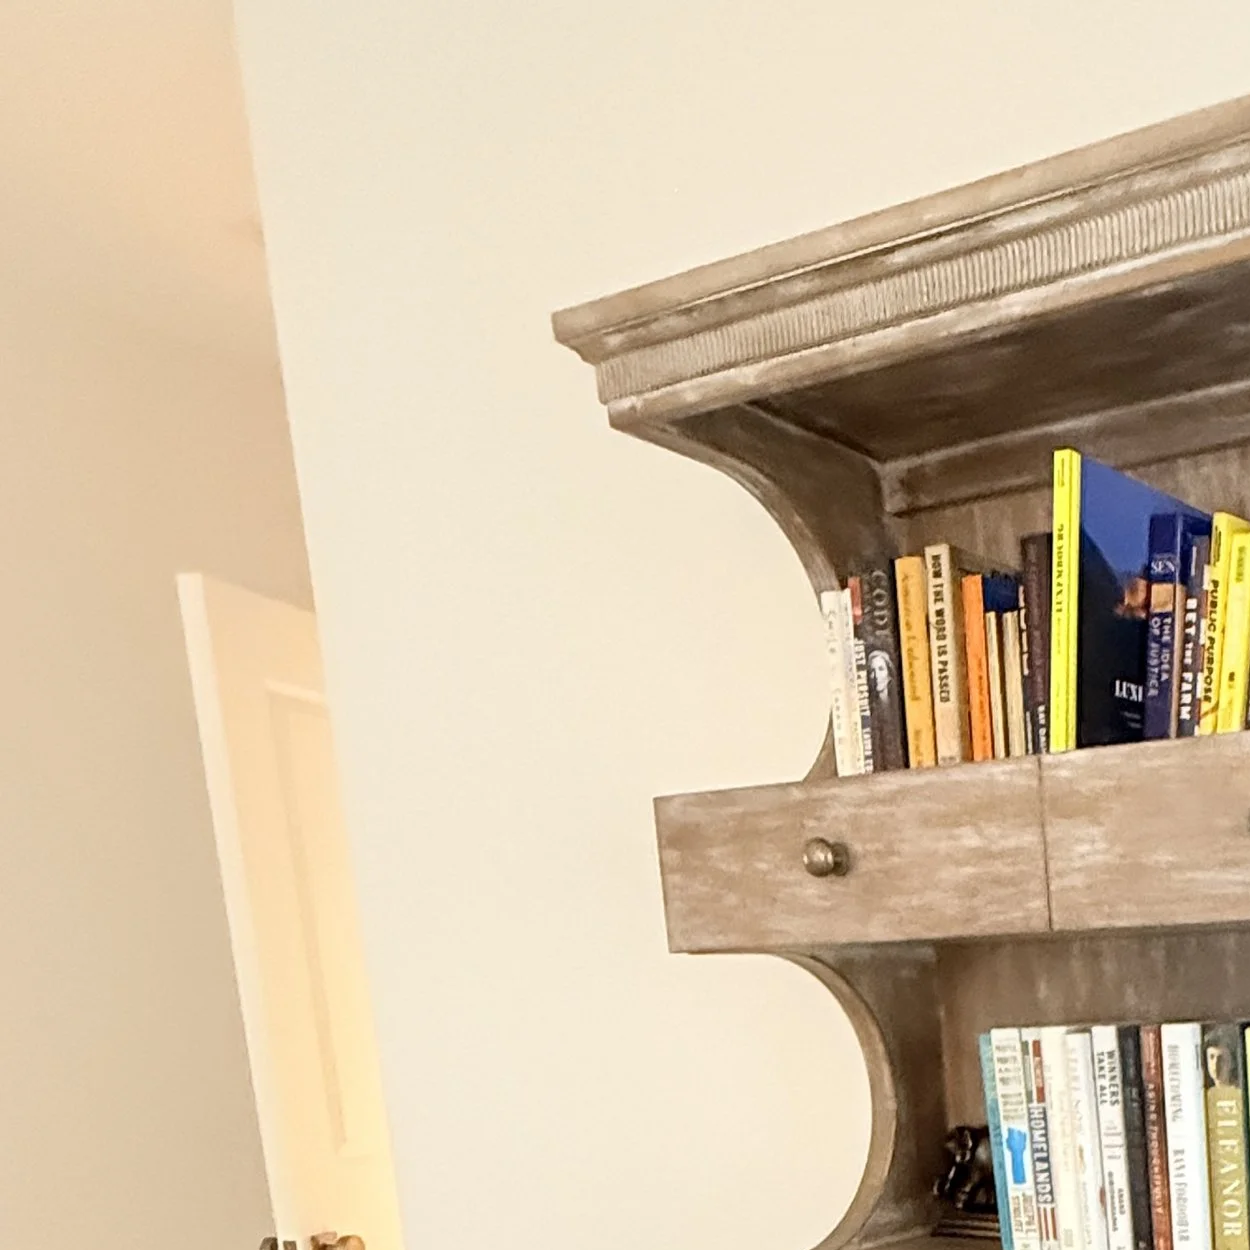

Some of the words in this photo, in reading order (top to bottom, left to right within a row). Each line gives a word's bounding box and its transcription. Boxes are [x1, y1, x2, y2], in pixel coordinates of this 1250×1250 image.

[931, 554, 943, 579] HOW
[934, 583, 944, 604] THE
[1208, 580, 1219, 632] PUBLIC
[935, 608, 947, 641] WORD
[1152, 618, 1160, 634] OF
[1161, 617, 1171, 642] THE
[1185, 598, 1197, 636] BET
[937, 645, 948, 656] IS
[1160, 649, 1170, 681] IDEA
[938, 660, 950, 703] PASSED
[1147, 640, 1159, 697] JUSTICE
[1203, 636, 1216, 703] PURPOSE
[1180, 672, 1193, 720] FARM
[1096, 1052, 1107, 1080] TAKE
[1107, 1050, 1120, 1107] WINNERS
[1099, 1085, 1109, 1106] ALL
[1030, 1107, 1050, 1204] HOMELANDS
[1216, 1099, 1243, 1237] ELEANOR
